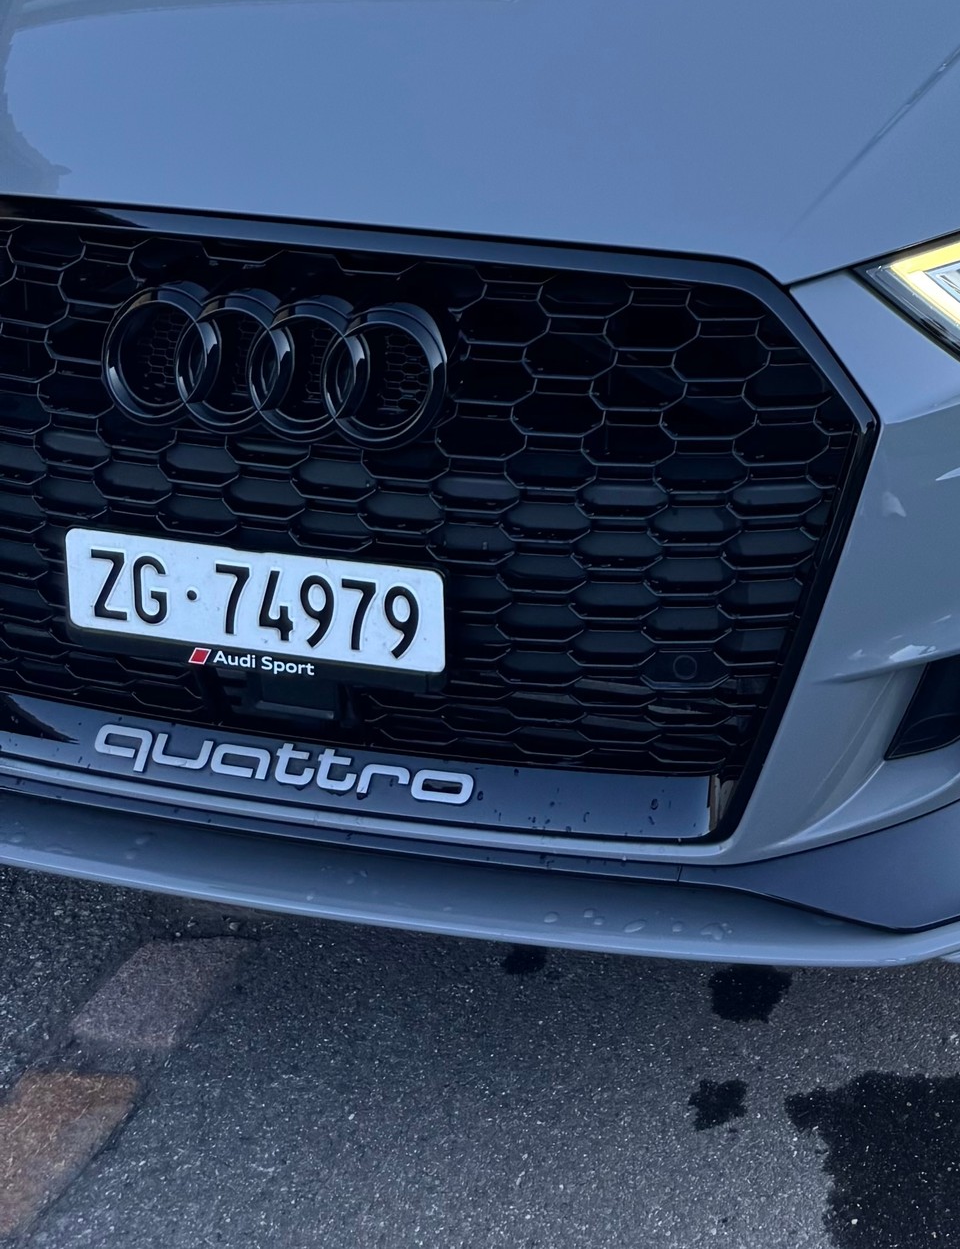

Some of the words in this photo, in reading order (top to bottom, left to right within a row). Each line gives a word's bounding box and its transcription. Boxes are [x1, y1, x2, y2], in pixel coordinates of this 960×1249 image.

[215, 562, 419, 659] 74979
[213, 650, 256, 668] Audi
[261, 655, 315, 676] Sport
[94, 723, 475, 804] quattro
